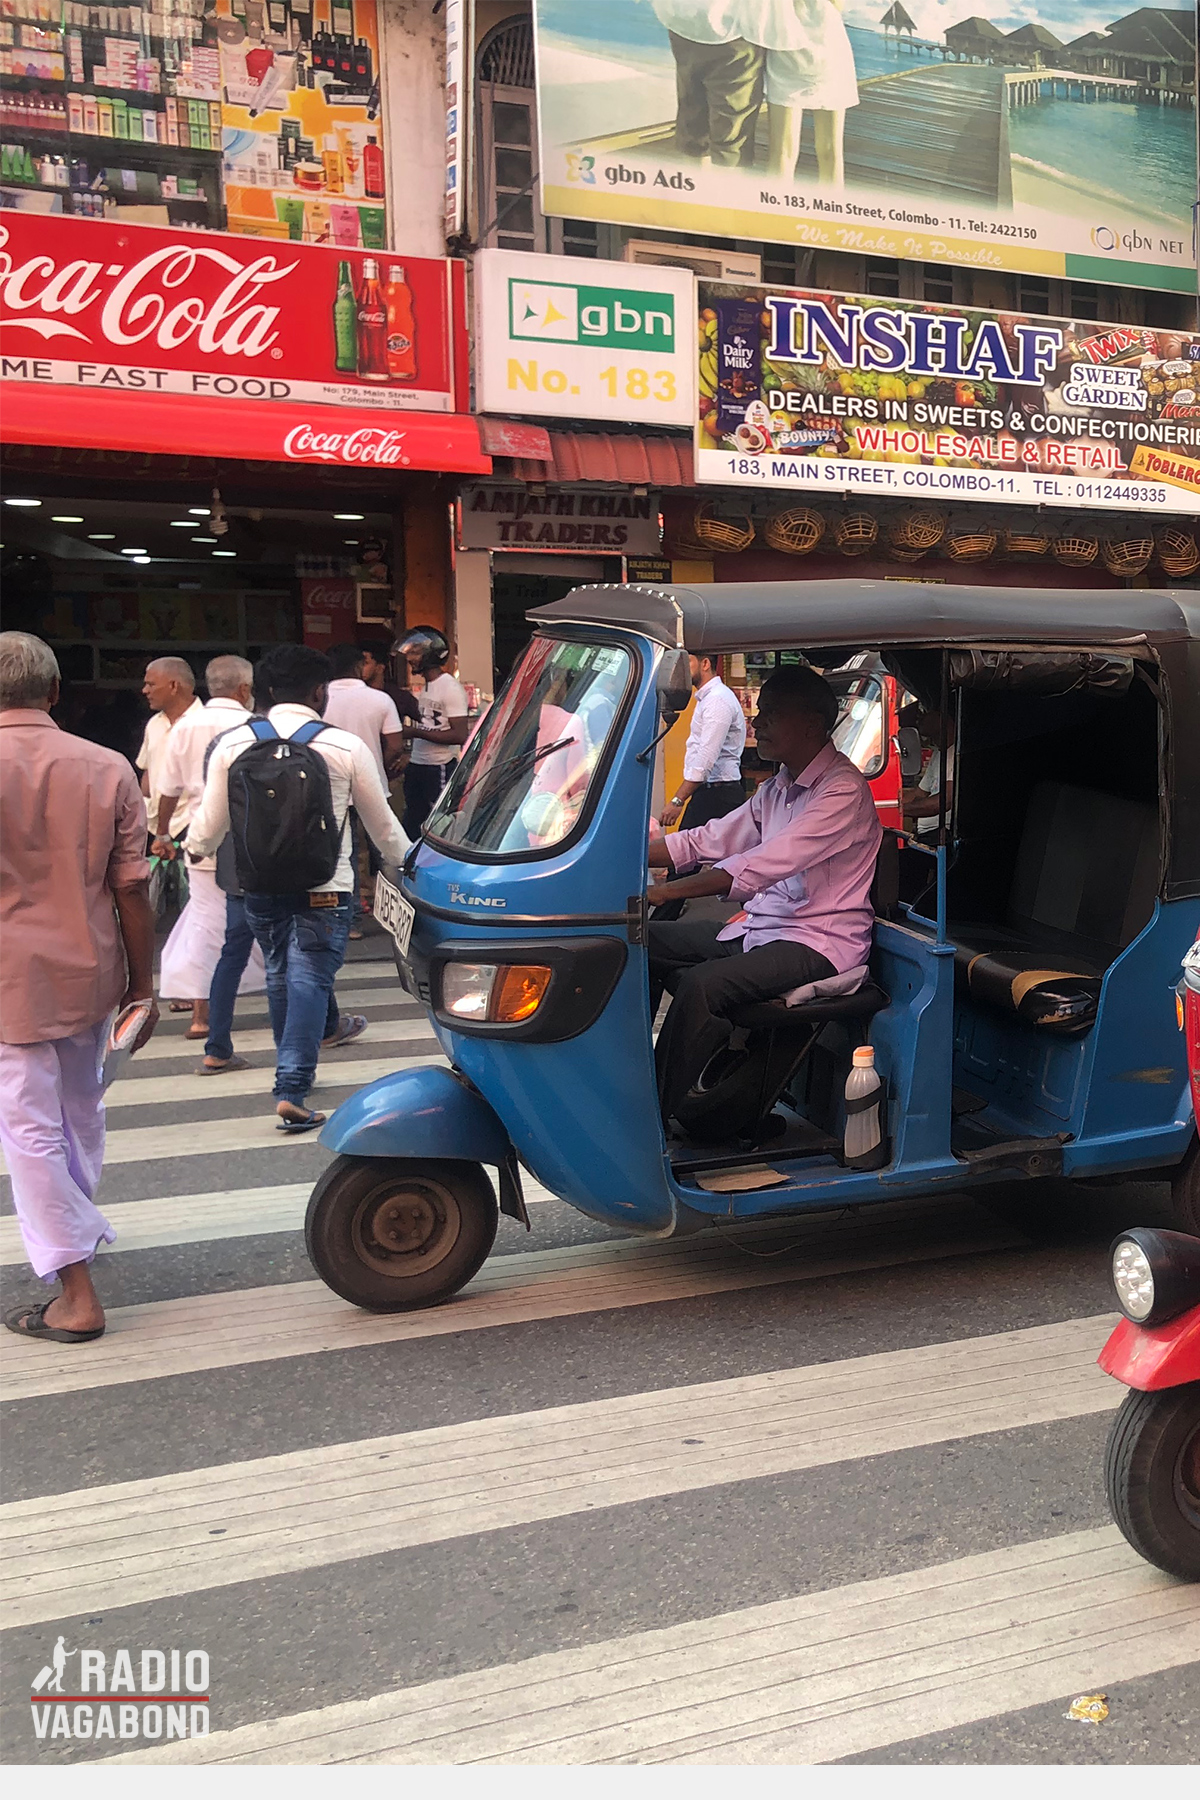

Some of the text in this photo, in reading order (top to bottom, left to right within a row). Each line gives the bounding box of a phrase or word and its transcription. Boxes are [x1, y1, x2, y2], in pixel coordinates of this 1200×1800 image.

[604, 163, 696, 192] gbn Ads
[760, 191, 781, 206] No.
[784, 194, 810, 211] 183,
[813, 198, 843, 215] Main
[845, 202, 886, 222] Street,
[888, 208, 939, 227] Colombo
[948, 217, 966, 231] 11.
[967, 219, 988, 234] Tel:
[990, 222, 1038, 240] 2422150
[796, 224, 1003, 266] We Make It Possible
[1160, 239, 1184, 255] NET
[581, 301, 673, 337] gbn
[723, 344, 754, 360] Dairy
[765, 296, 1062, 386] INSHAF
[1080, 328, 1140, 364] TWIX
[724, 357, 753, 370] Milk
[1073, 367, 1139, 387] SWEET
[77, 364, 168, 389] FAST
[191, 374, 291, 399] FOOD
[364, 389, 385, 397] Main
[507, 358, 677, 403] No. 183
[340, 396, 384, 406] Colombo
[769, 390, 878, 418] DEALERS
[885, 401, 907, 421] IN
[913, 403, 1003, 430] SWEETS
[1010, 411, 1026, 431] &
[1066, 386, 1146, 408] GARDEN
[284, 424, 407, 464] Coca-Cola
[780, 429, 831, 444] BOUNTY
[855, 427, 1127, 471] WHOLESALE & RETAIL
[728, 459, 1166, 503] 183, MAIN STREET, COLOMBO-11. TEL 0112449335
[579, 495, 650, 520] KHAN
[498, 520, 628, 546] TRADERS
[447, 883, 460, 892] TVS
